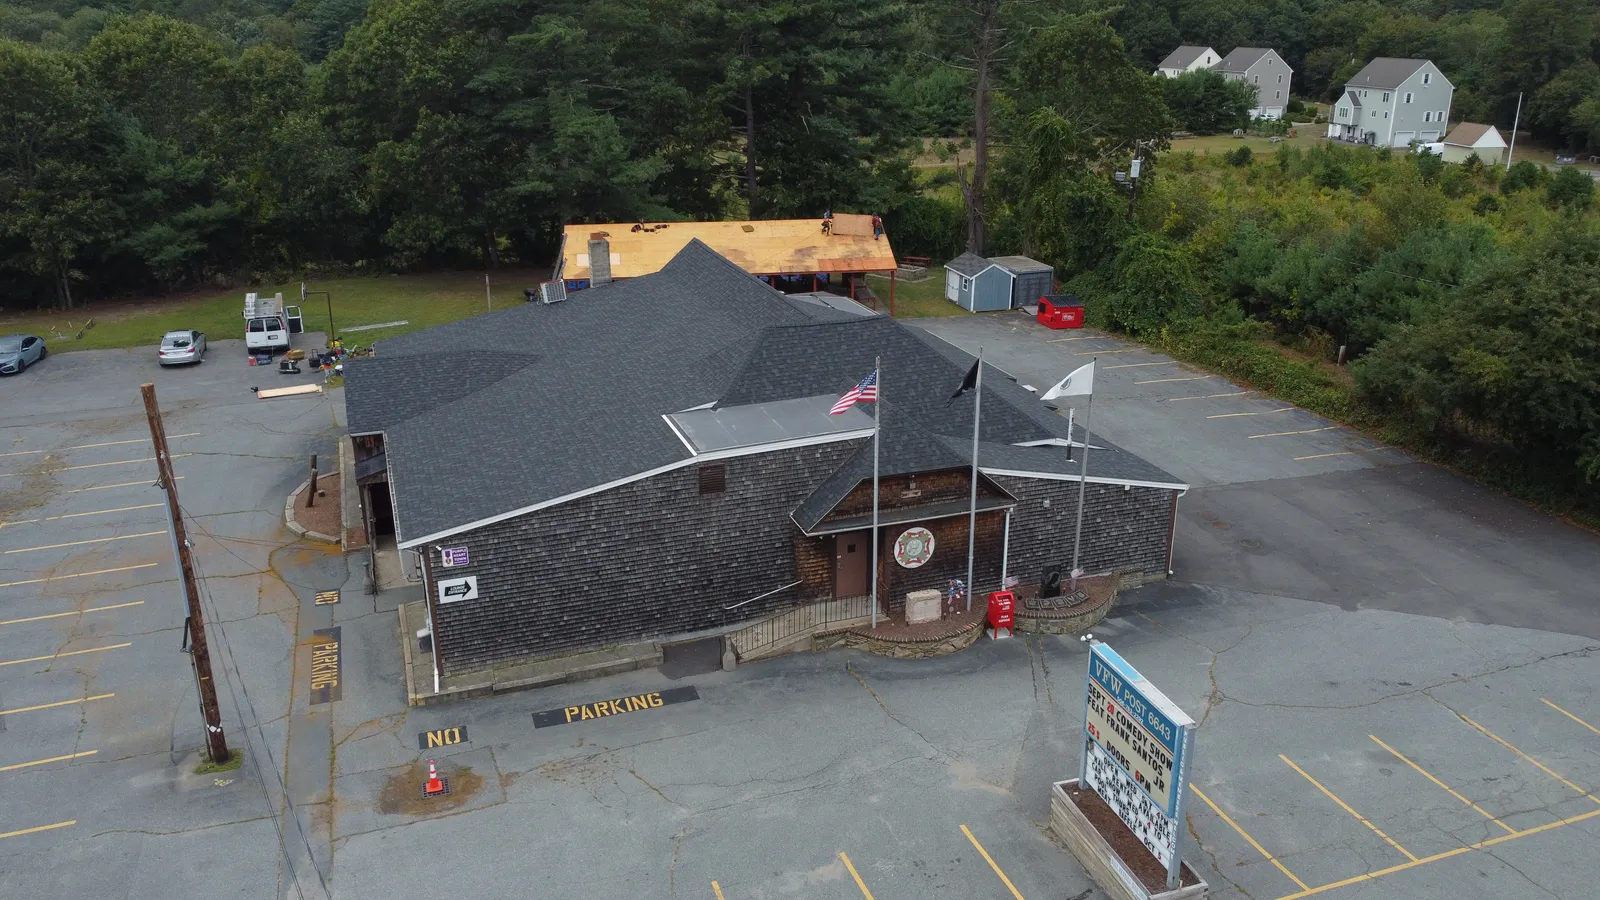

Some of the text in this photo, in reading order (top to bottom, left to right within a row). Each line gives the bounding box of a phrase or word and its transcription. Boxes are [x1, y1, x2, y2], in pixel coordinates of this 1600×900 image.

[315, 591, 338, 605] NO
[312, 642, 338, 690] PARKING
[564, 692, 664, 723] PARKING
[1095, 659, 1122, 694] VFW
[1124, 689, 1147, 717] POST
[1148, 712, 1171, 741] 6643
[427, 727, 461, 748] NO
[1087, 696, 1104, 718] FEAT
[1106, 713, 1130, 745] FRANK
[1132, 740, 1163, 777] SANTOS
[1088, 683, 1106, 706] SEPT
[1107, 701, 1115, 715] 20
[1116, 710, 1148, 746] COMEDY
[1149, 741, 1173, 772] SHOW
[1103, 757, 1119, 776] OPEN
[1125, 778, 1137, 795] WED
[1106, 740, 1130, 771] DOORS
[1135, 770, 1151, 794] 6PM
[1153, 776, 1165, 793] JR
[1112, 774, 1134, 801] RENTAL
[1139, 802, 1171, 841] AVAILABLE
[1144, 837, 1155, 853] OCT
